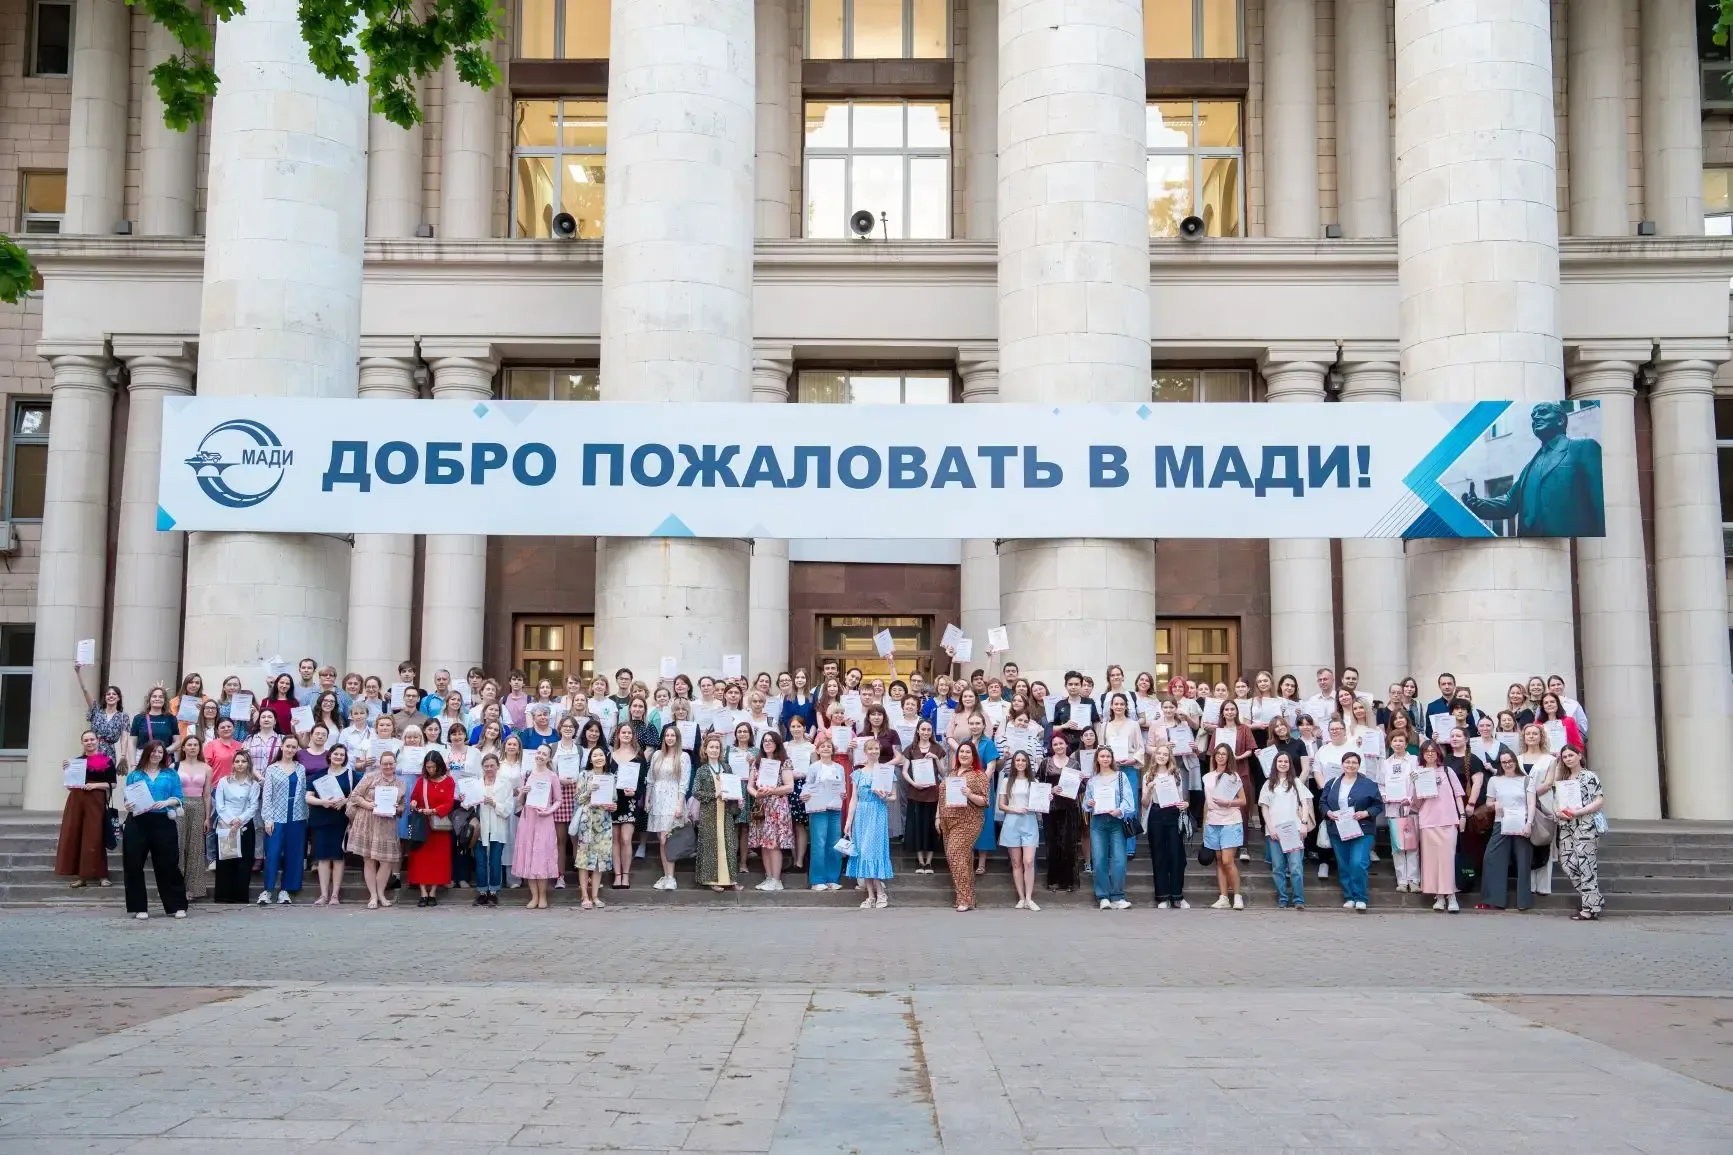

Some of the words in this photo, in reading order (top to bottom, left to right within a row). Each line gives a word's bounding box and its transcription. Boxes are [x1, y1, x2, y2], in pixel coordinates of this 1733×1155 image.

[242, 449, 294, 469] МАДИ
[322, 441, 557, 493] ДОБРО
[582, 443, 1064, 490] ПОЖАЛОВАТЬ
[1089, 445, 1130, 488] В
[1154, 445, 1371, 498] МАДИ!
